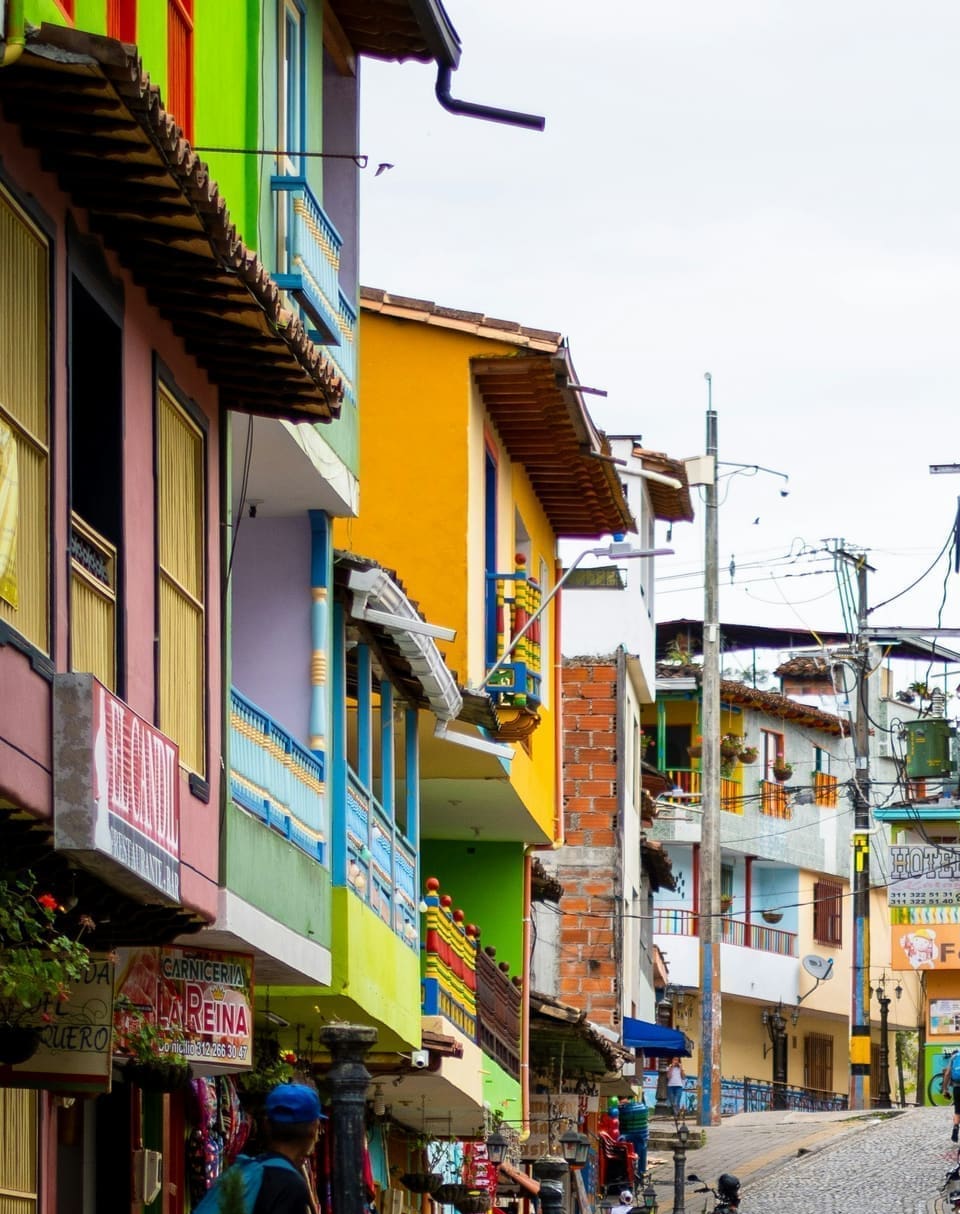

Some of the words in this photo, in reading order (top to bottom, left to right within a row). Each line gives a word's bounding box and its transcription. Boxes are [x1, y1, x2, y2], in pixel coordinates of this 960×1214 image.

[185, 980, 249, 1037] REINA
[196, 1042, 211, 1056] 312
[212, 1043, 226, 1057] 266
[228, 1045, 237, 1058] 30
[238, 1046, 248, 1060] 47
